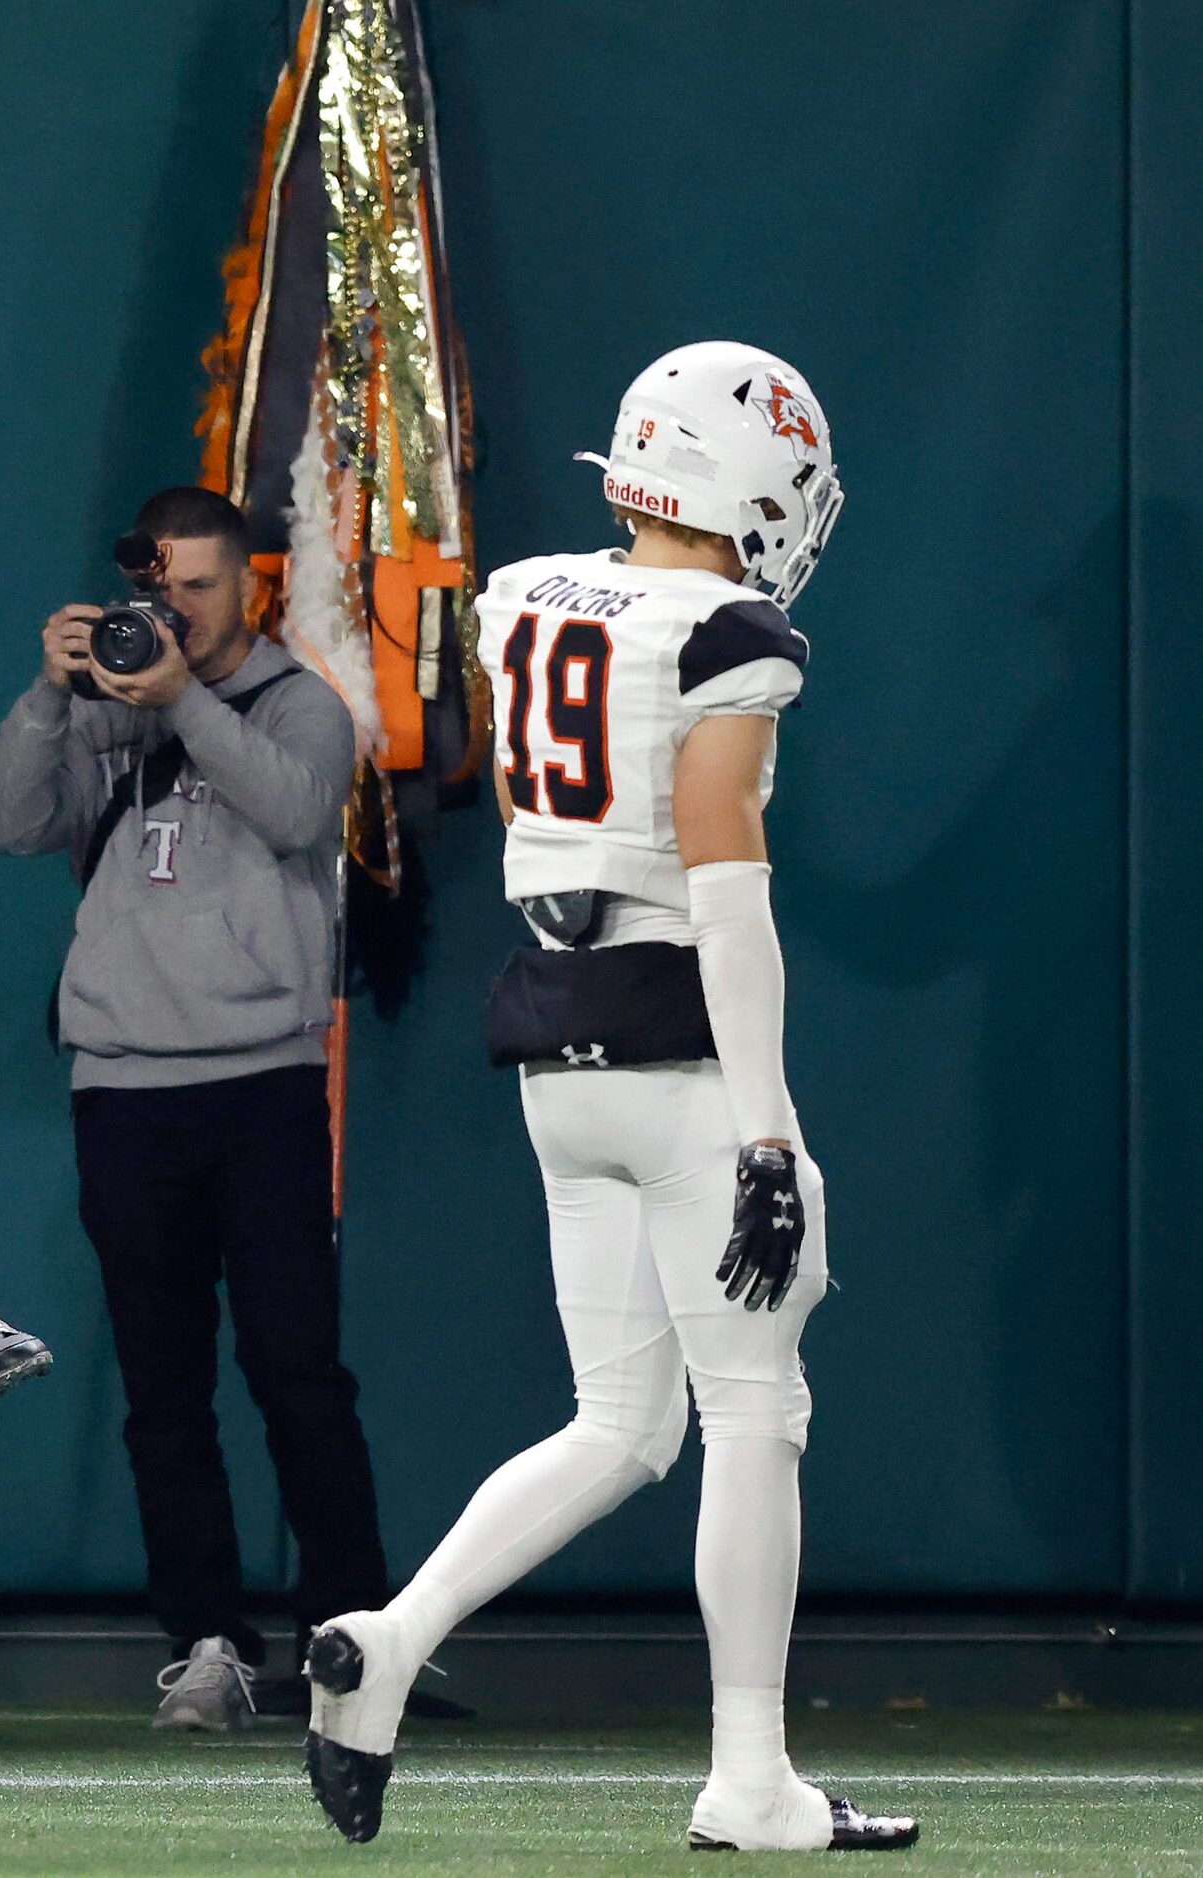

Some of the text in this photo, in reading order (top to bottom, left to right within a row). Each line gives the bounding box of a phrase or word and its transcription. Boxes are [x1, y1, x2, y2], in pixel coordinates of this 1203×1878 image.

[638, 418, 655, 440] 19
[605, 478, 679, 518] Riddell
[525, 575, 646, 618] OWENS
[503, 611, 614, 824] 19
[145, 818, 181, 884] T
